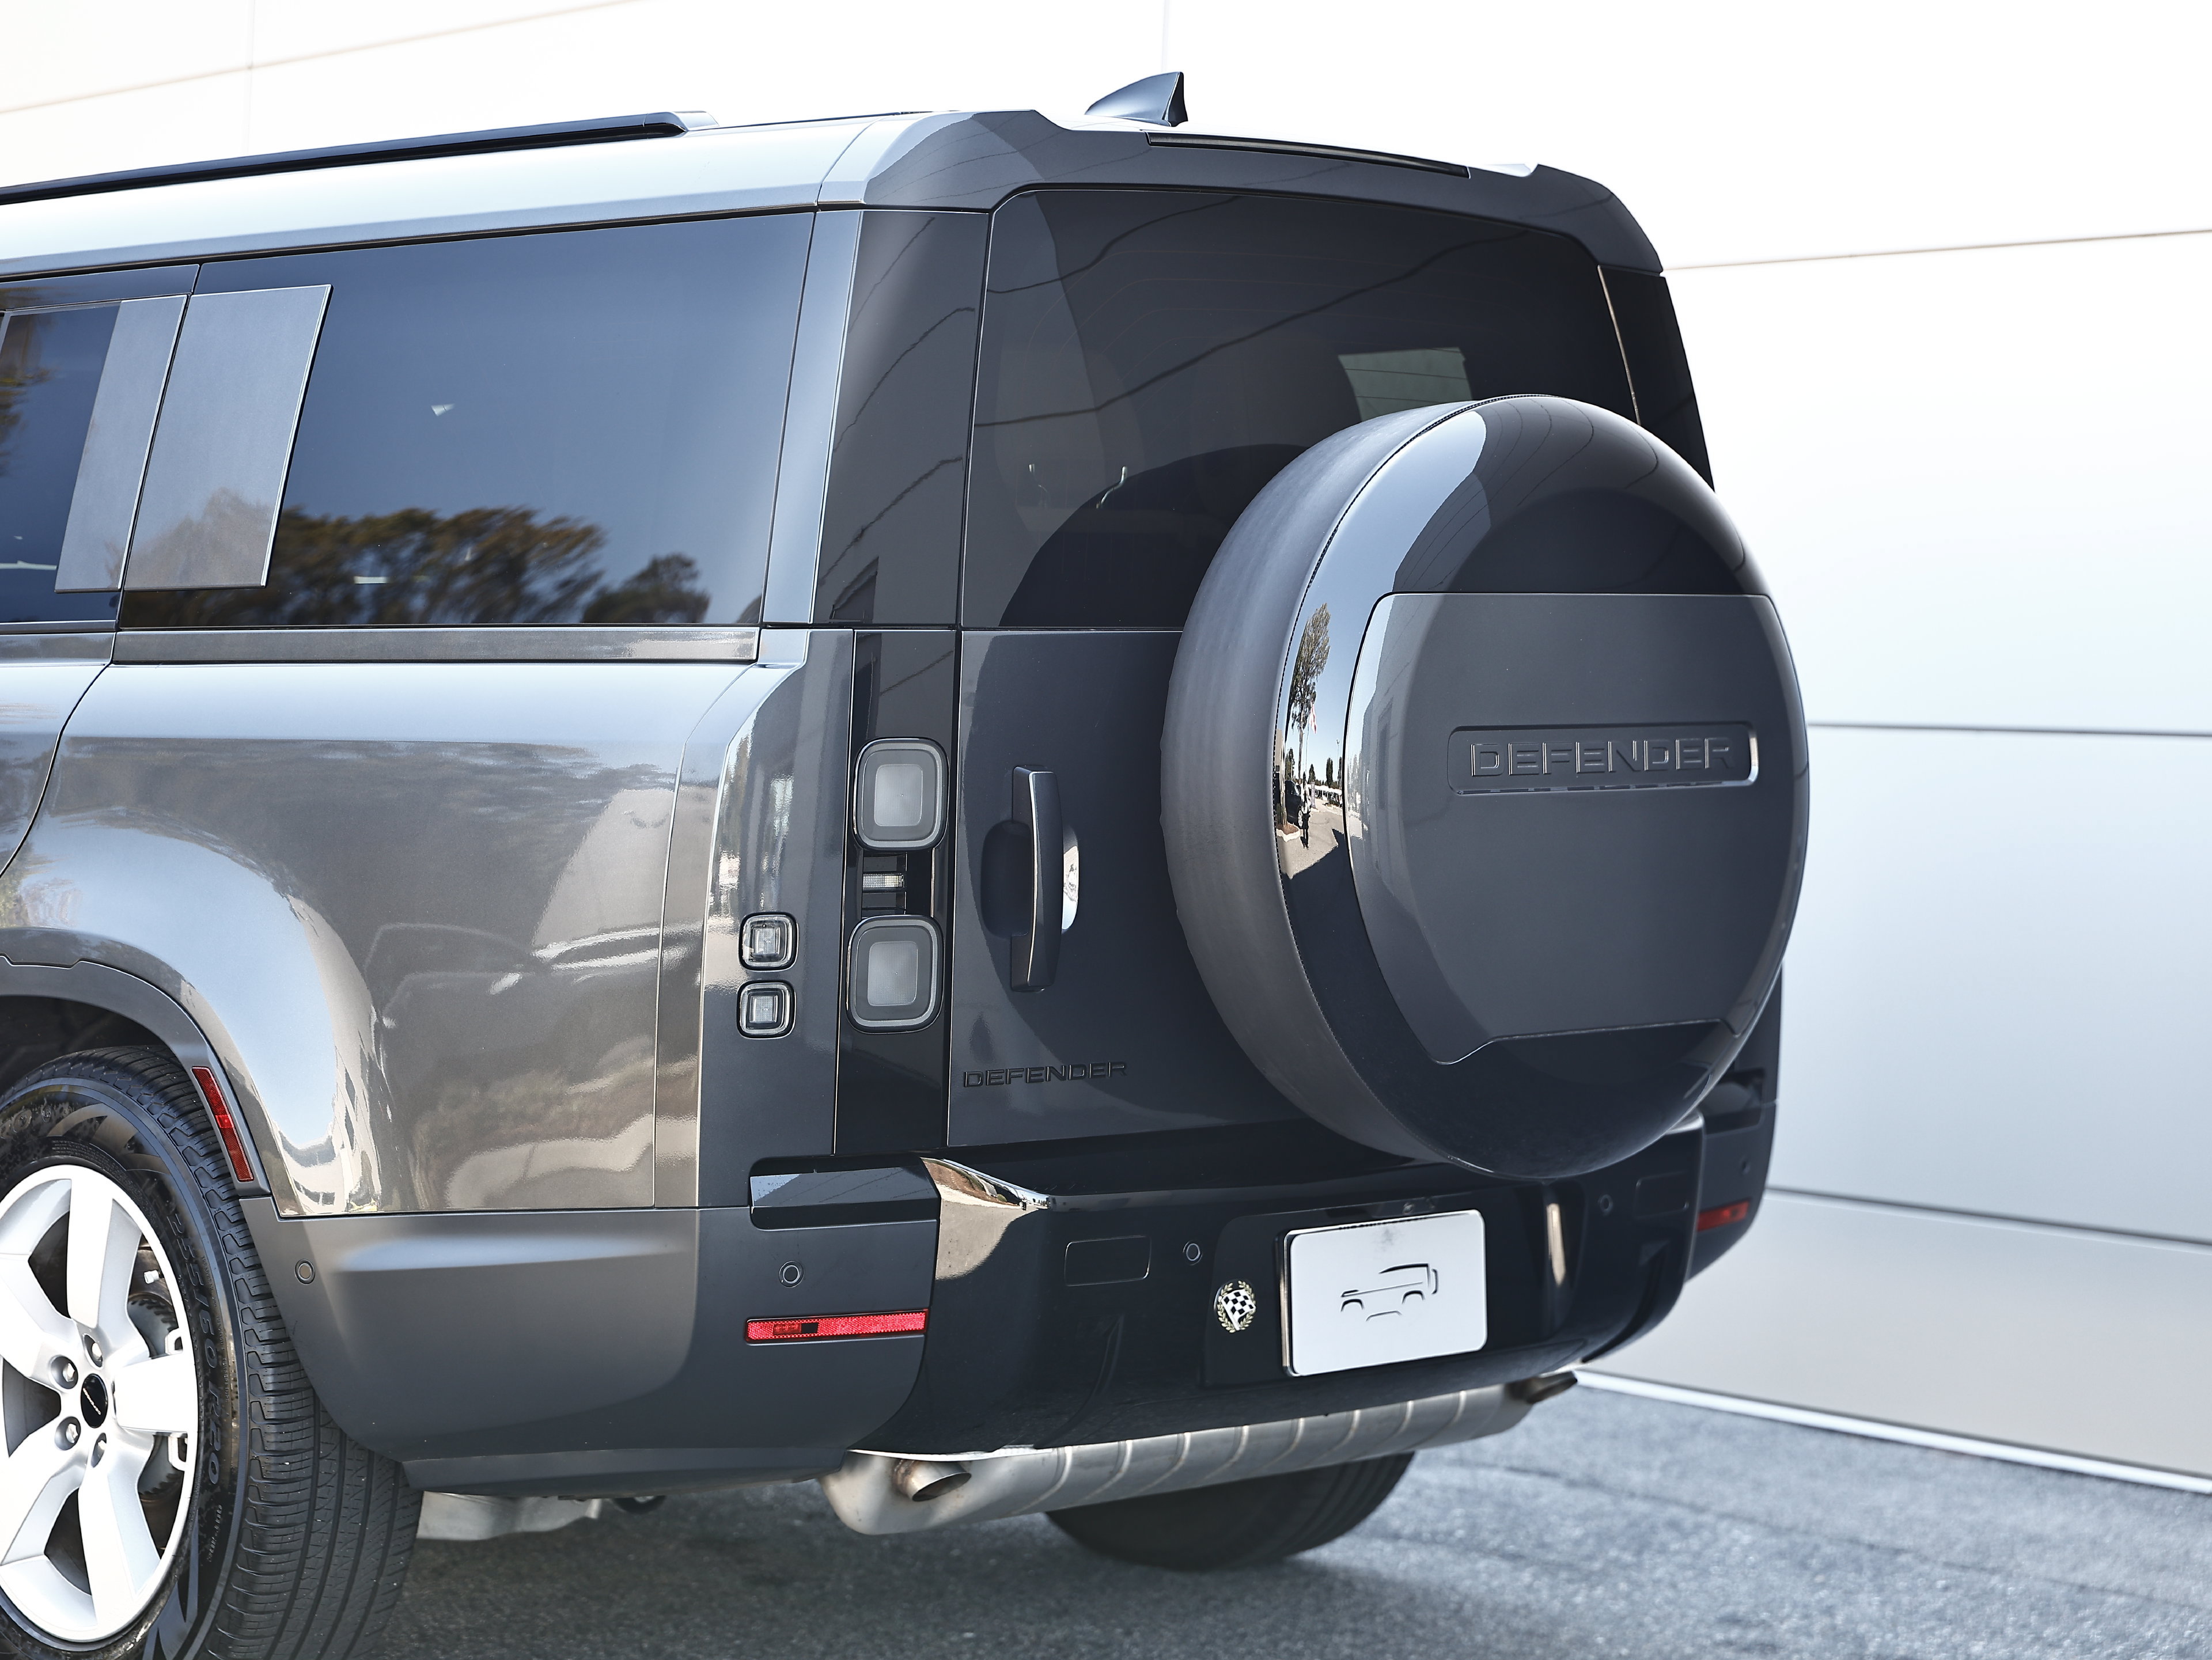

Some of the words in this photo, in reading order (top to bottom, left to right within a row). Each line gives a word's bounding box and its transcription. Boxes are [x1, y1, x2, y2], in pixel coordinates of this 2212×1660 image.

[1470, 737, 1734, 776] DEFENDER
[964, 1061, 1127, 1087] DEFENDER
[166, 1212, 218, 1369] 255/60
